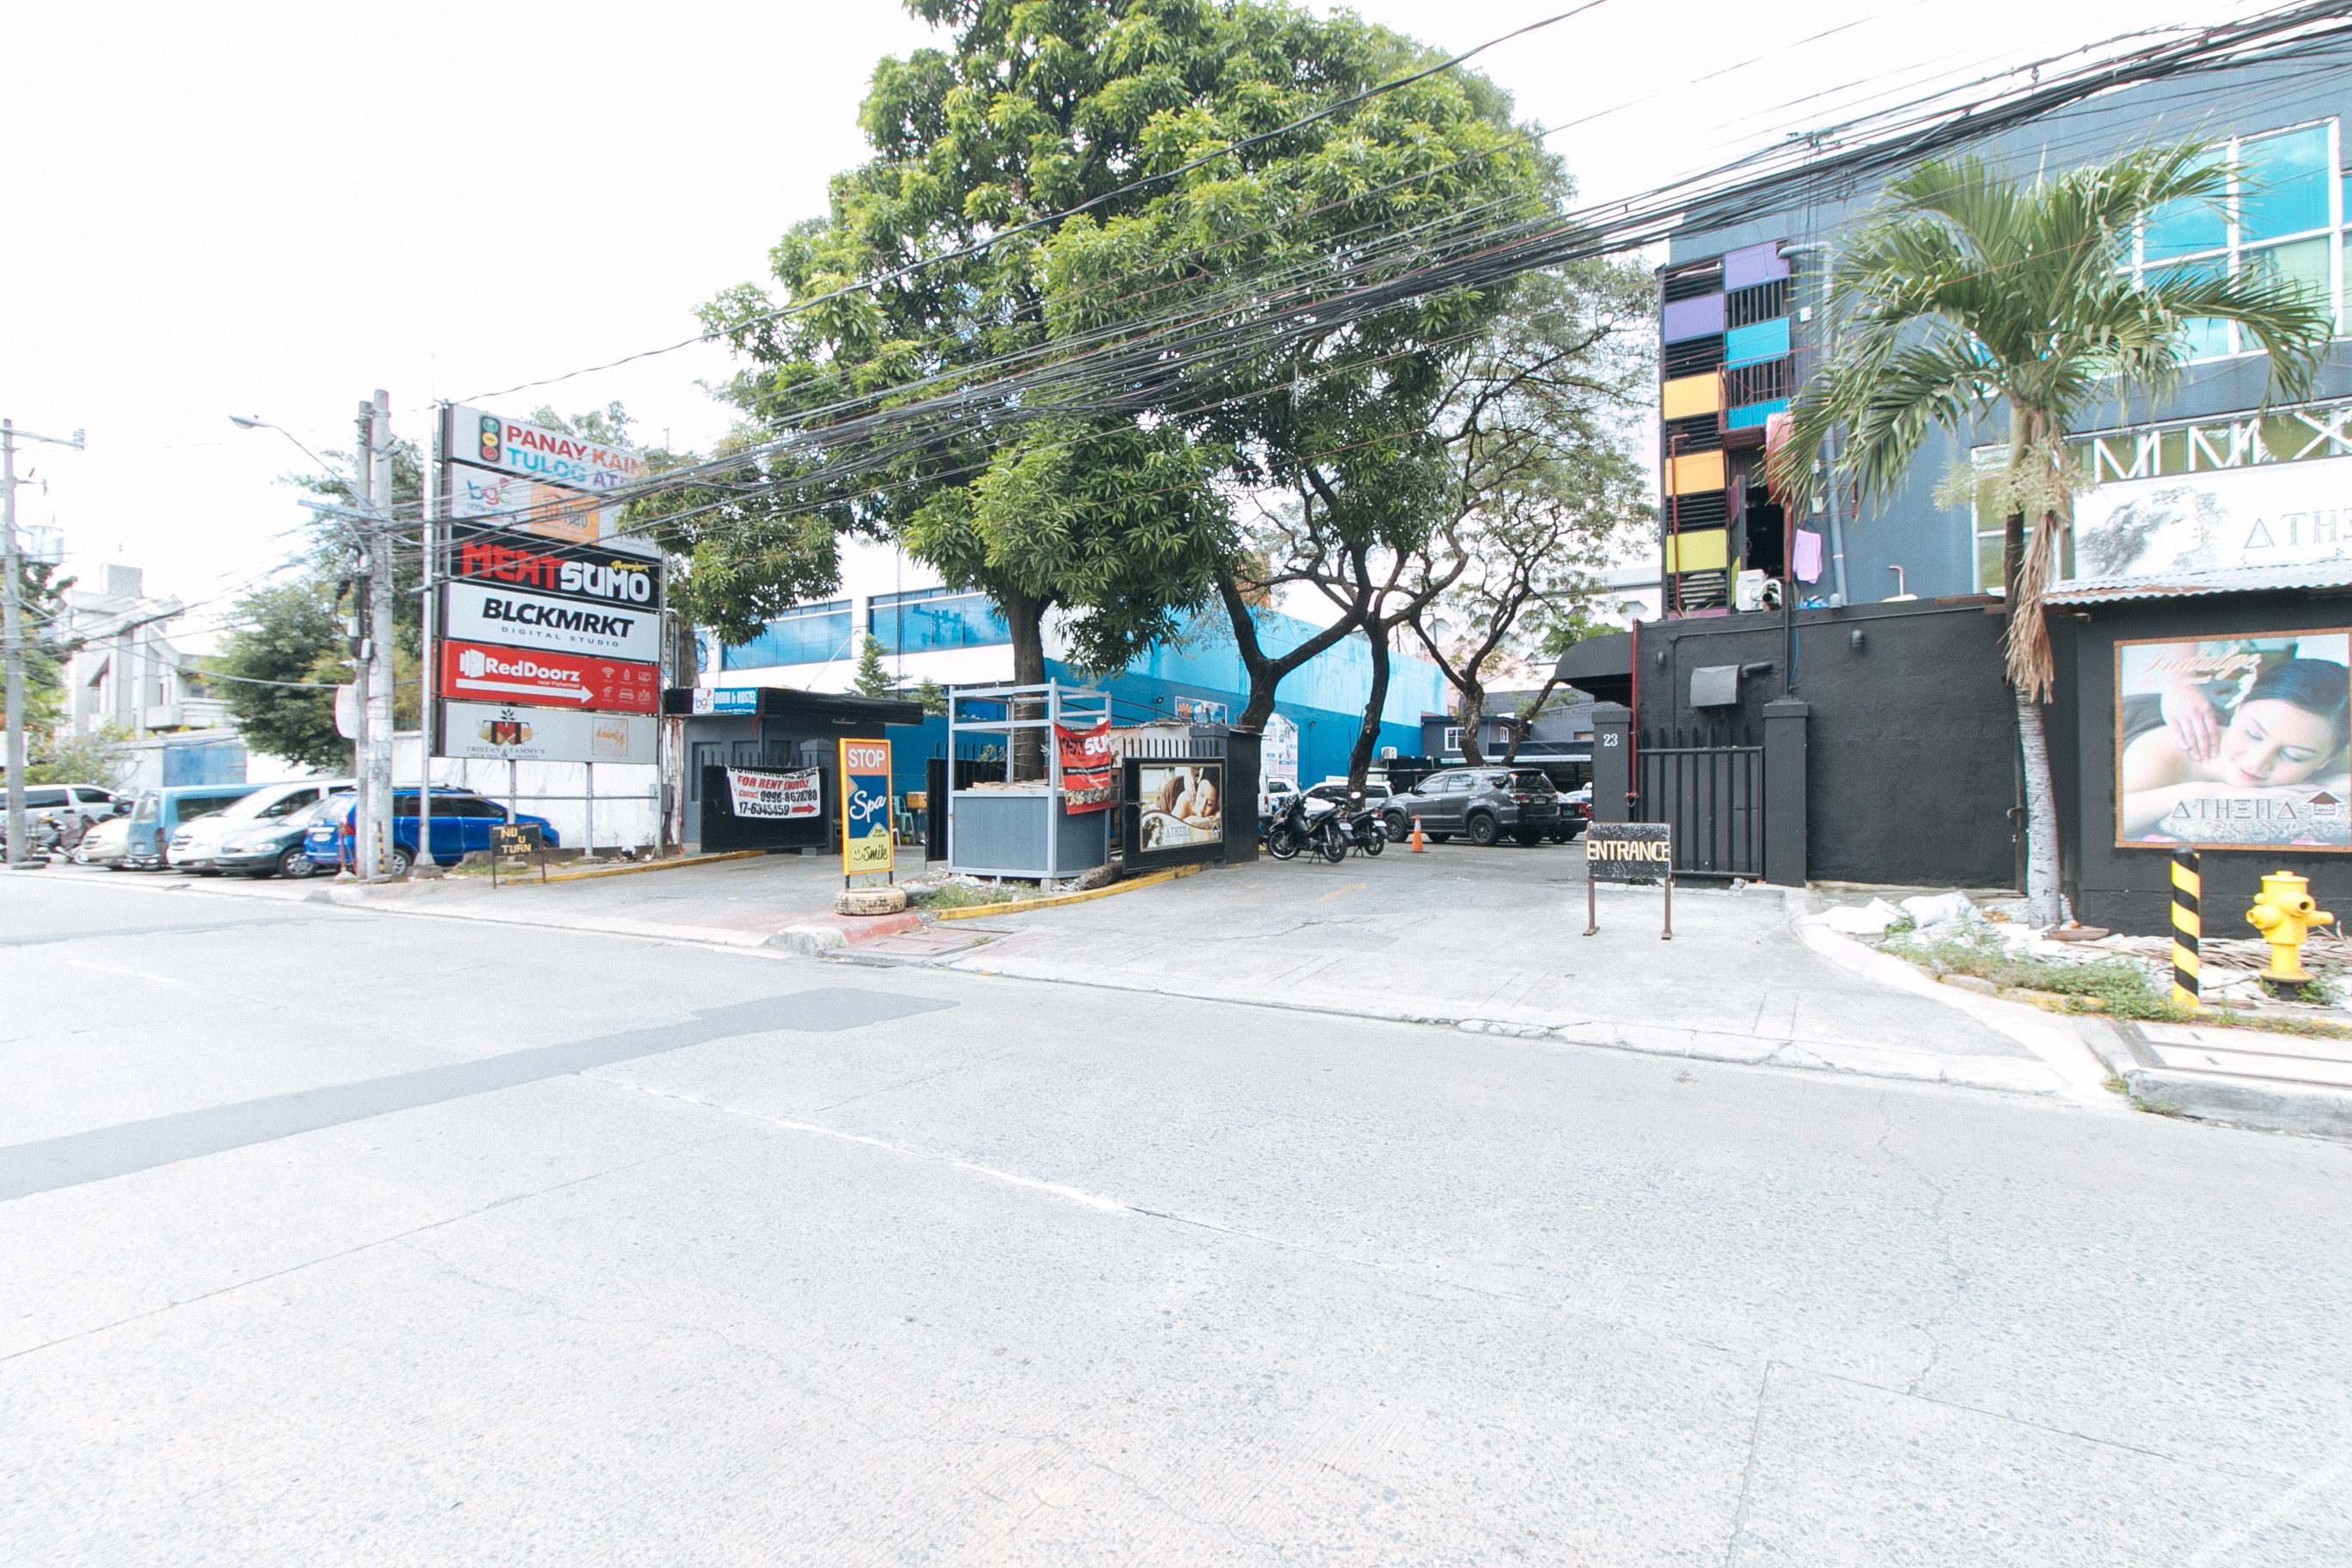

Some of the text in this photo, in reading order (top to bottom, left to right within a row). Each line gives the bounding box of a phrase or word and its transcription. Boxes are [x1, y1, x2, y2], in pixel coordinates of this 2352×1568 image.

[507, 425, 587, 460] PANAY
[506, 447, 586, 482] TULOG
[482, 597, 634, 638] BLCKMRKT
[501, 627, 620, 647] DIGITAL STUDIO
[485, 657, 580, 683] RedDoorz
[1603, 733, 1618, 747] 23
[848, 749, 885, 768] STOP
[738, 775, 756, 788] FOR
[758, 779, 783, 790] RENT
[849, 790, 886, 823] Spa
[500, 827, 518, 839] NO
[501, 843, 531, 854] TURN
[863, 844, 888, 861] Smile
[1587, 840, 1670, 862] ENTRANCE
